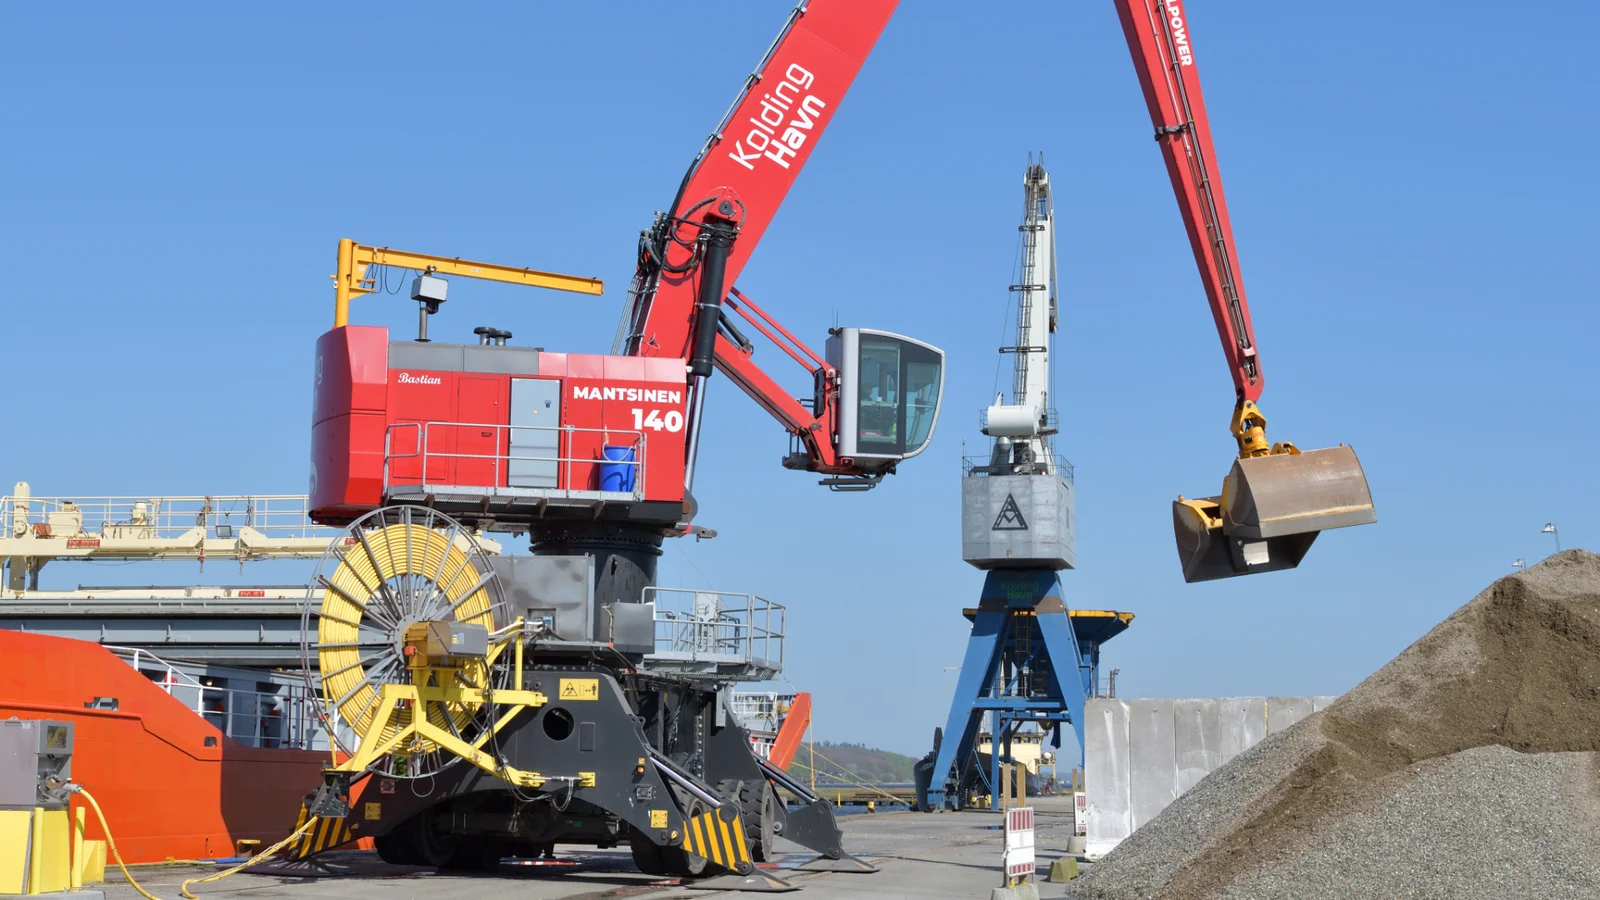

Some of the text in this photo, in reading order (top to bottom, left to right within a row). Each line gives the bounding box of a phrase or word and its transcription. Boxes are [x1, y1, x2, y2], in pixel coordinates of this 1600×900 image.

[728, 63, 814, 170] Kolding
[764, 94, 826, 169] Havn
[398, 372, 442, 385] Bastian
[573, 386, 681, 404] MANTSINEN
[631, 408, 684, 433] 140
